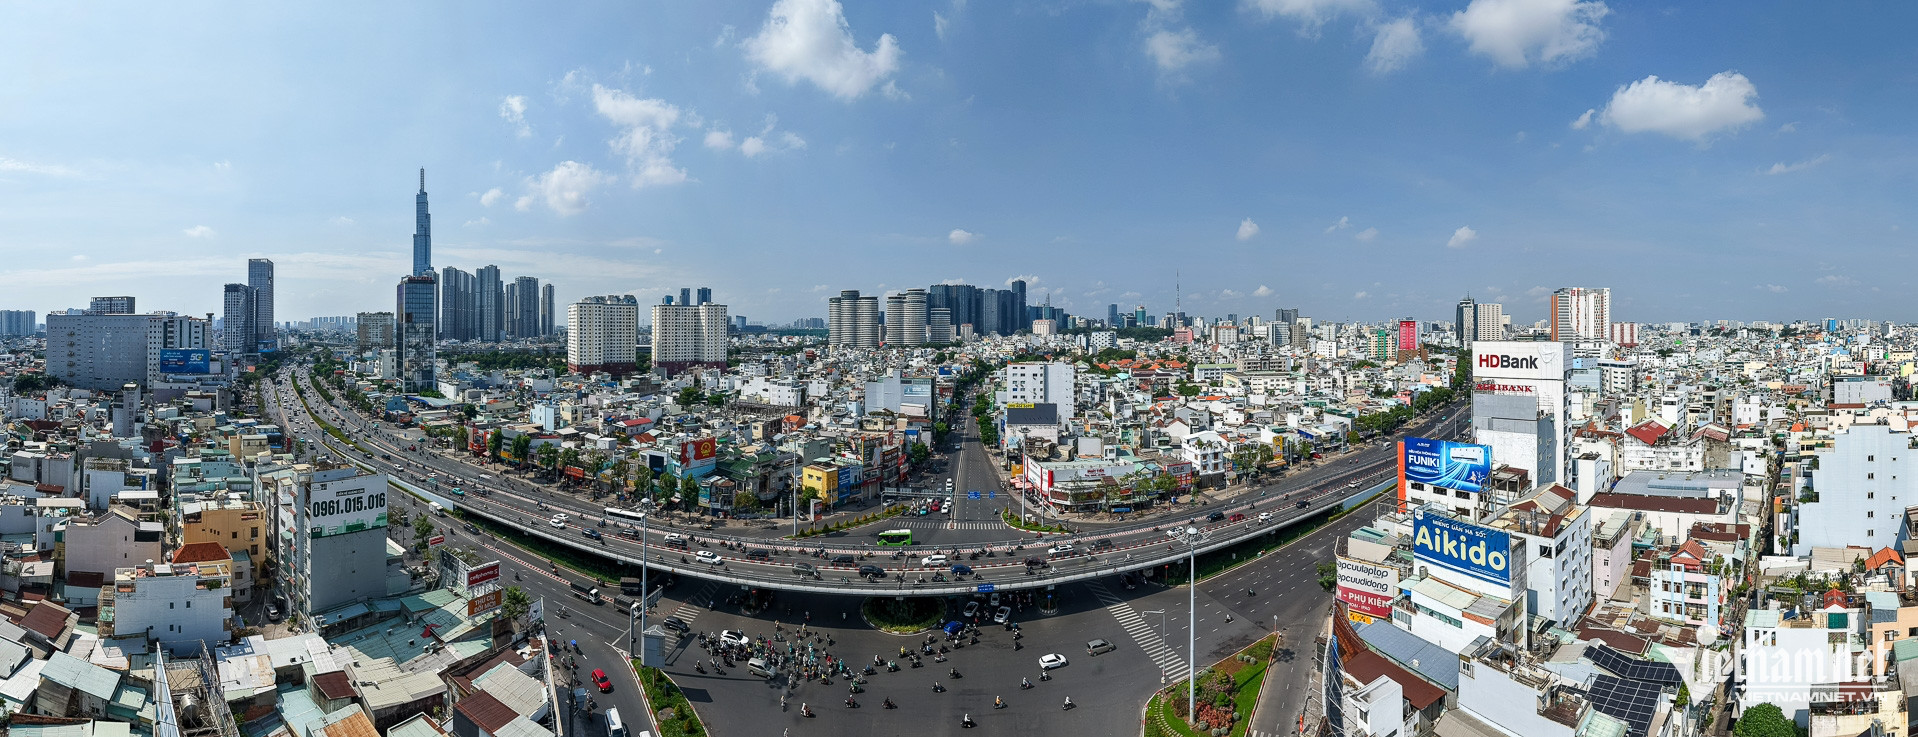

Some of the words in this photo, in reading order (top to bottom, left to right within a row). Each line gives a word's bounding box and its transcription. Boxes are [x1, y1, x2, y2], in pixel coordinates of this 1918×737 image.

[1479, 354, 1538, 369] HDBank
[1476, 384, 1532, 392] AGRIBANK
[1408, 454, 1440, 467] FUNIKI
[312, 492, 386, 518] 0961.015.016
[1415, 525, 1506, 570] Aikido
[1348, 592, 1366, 604] PHỤ
